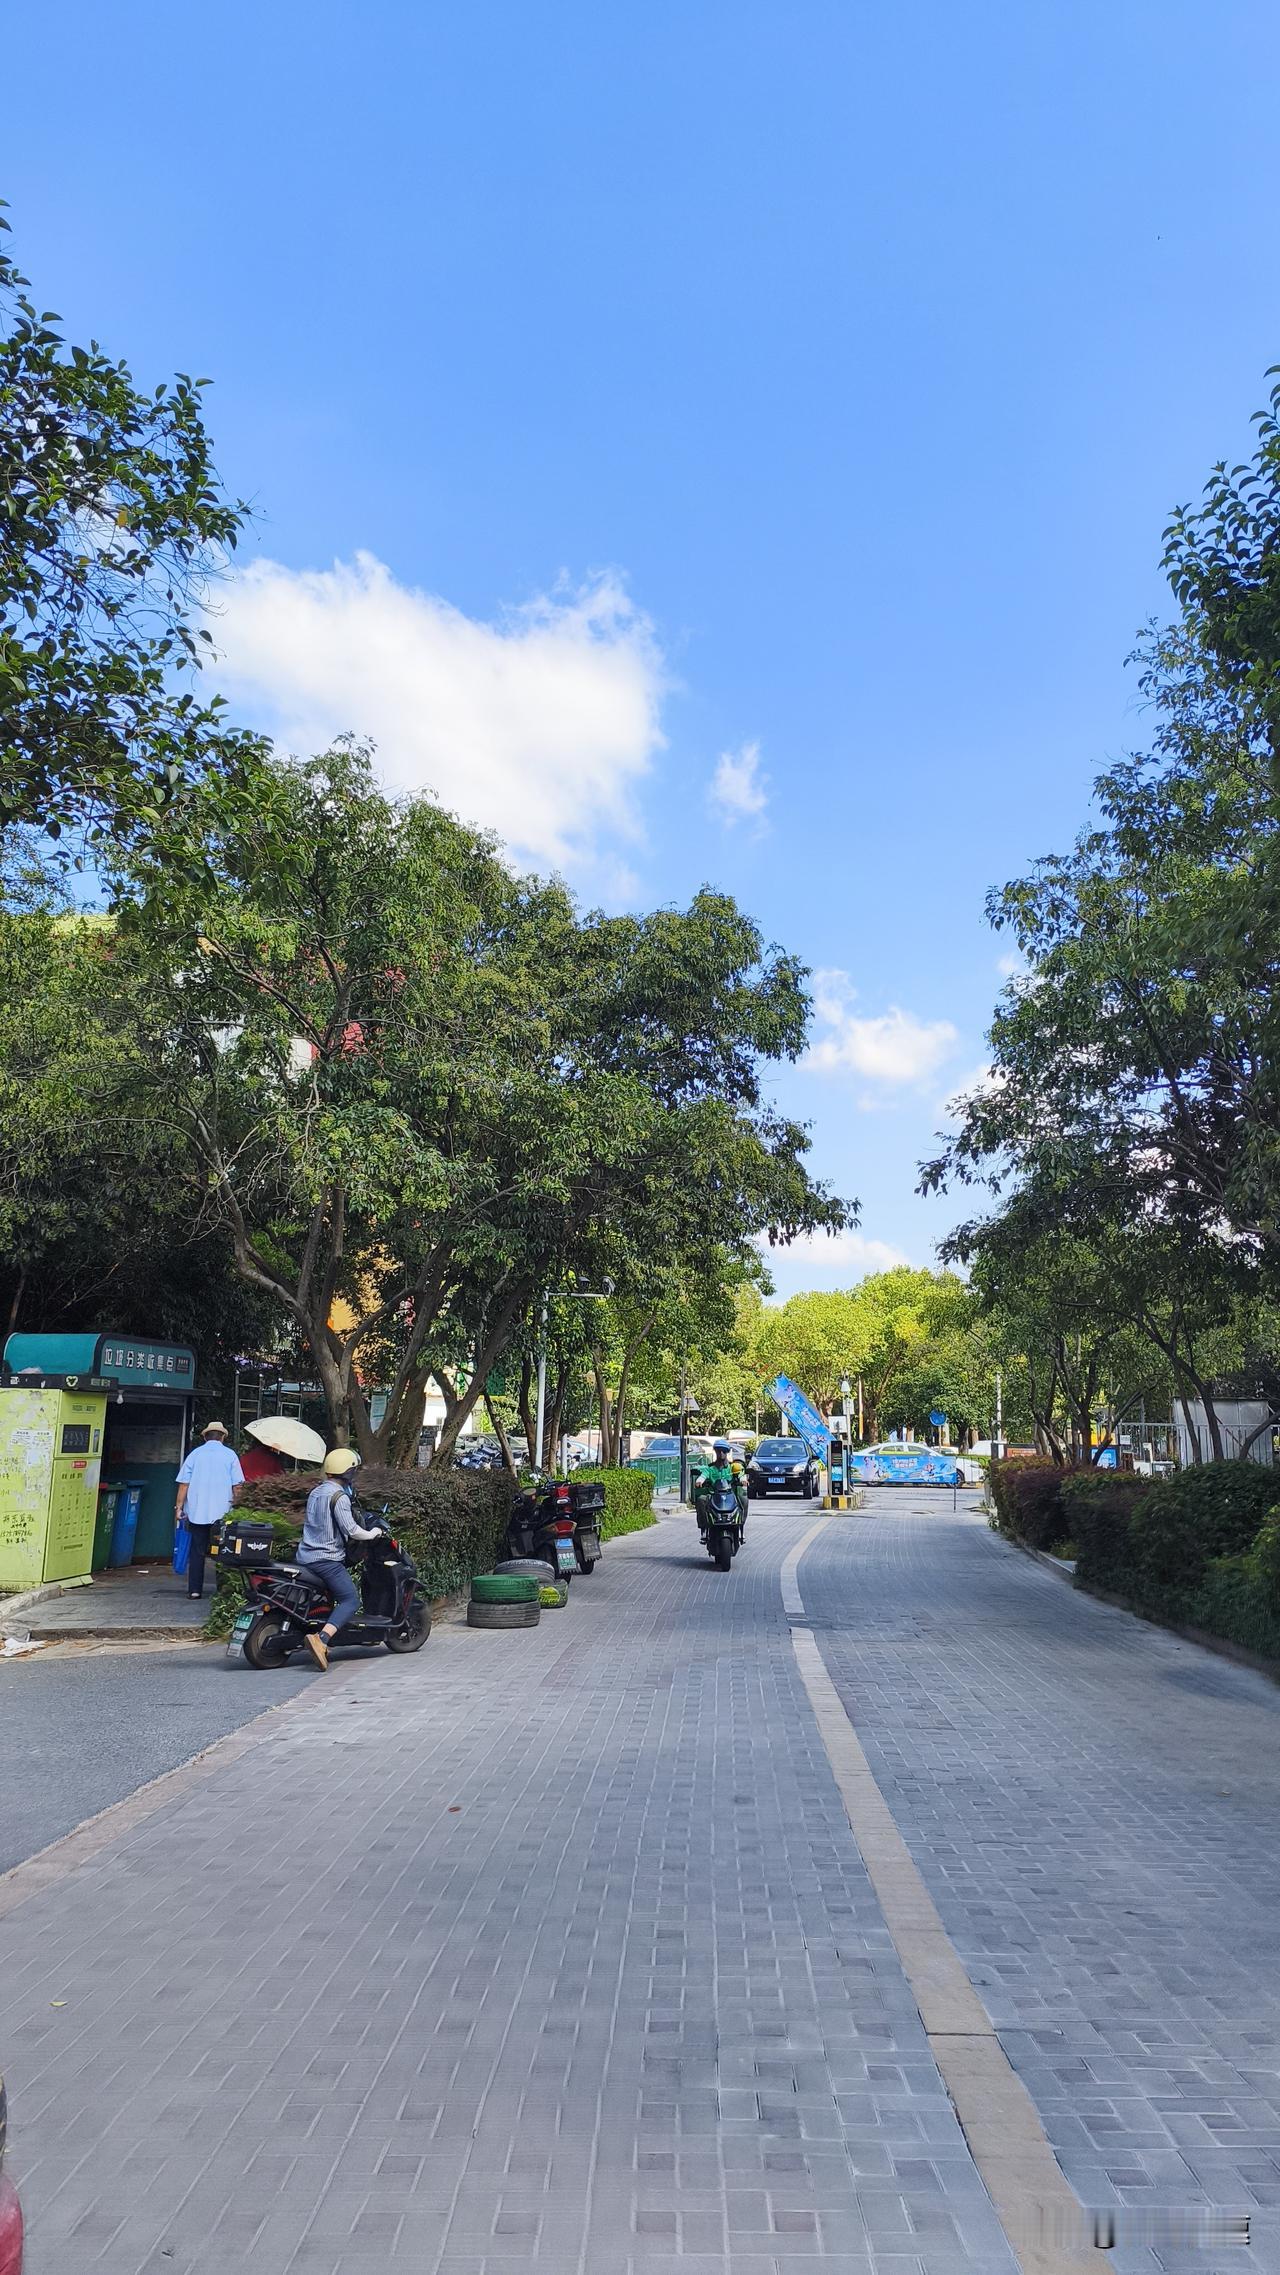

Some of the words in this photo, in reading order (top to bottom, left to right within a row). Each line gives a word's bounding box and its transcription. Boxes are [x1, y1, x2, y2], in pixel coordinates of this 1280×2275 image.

[104, 1347, 174, 1372] 垃圾分类收集点
